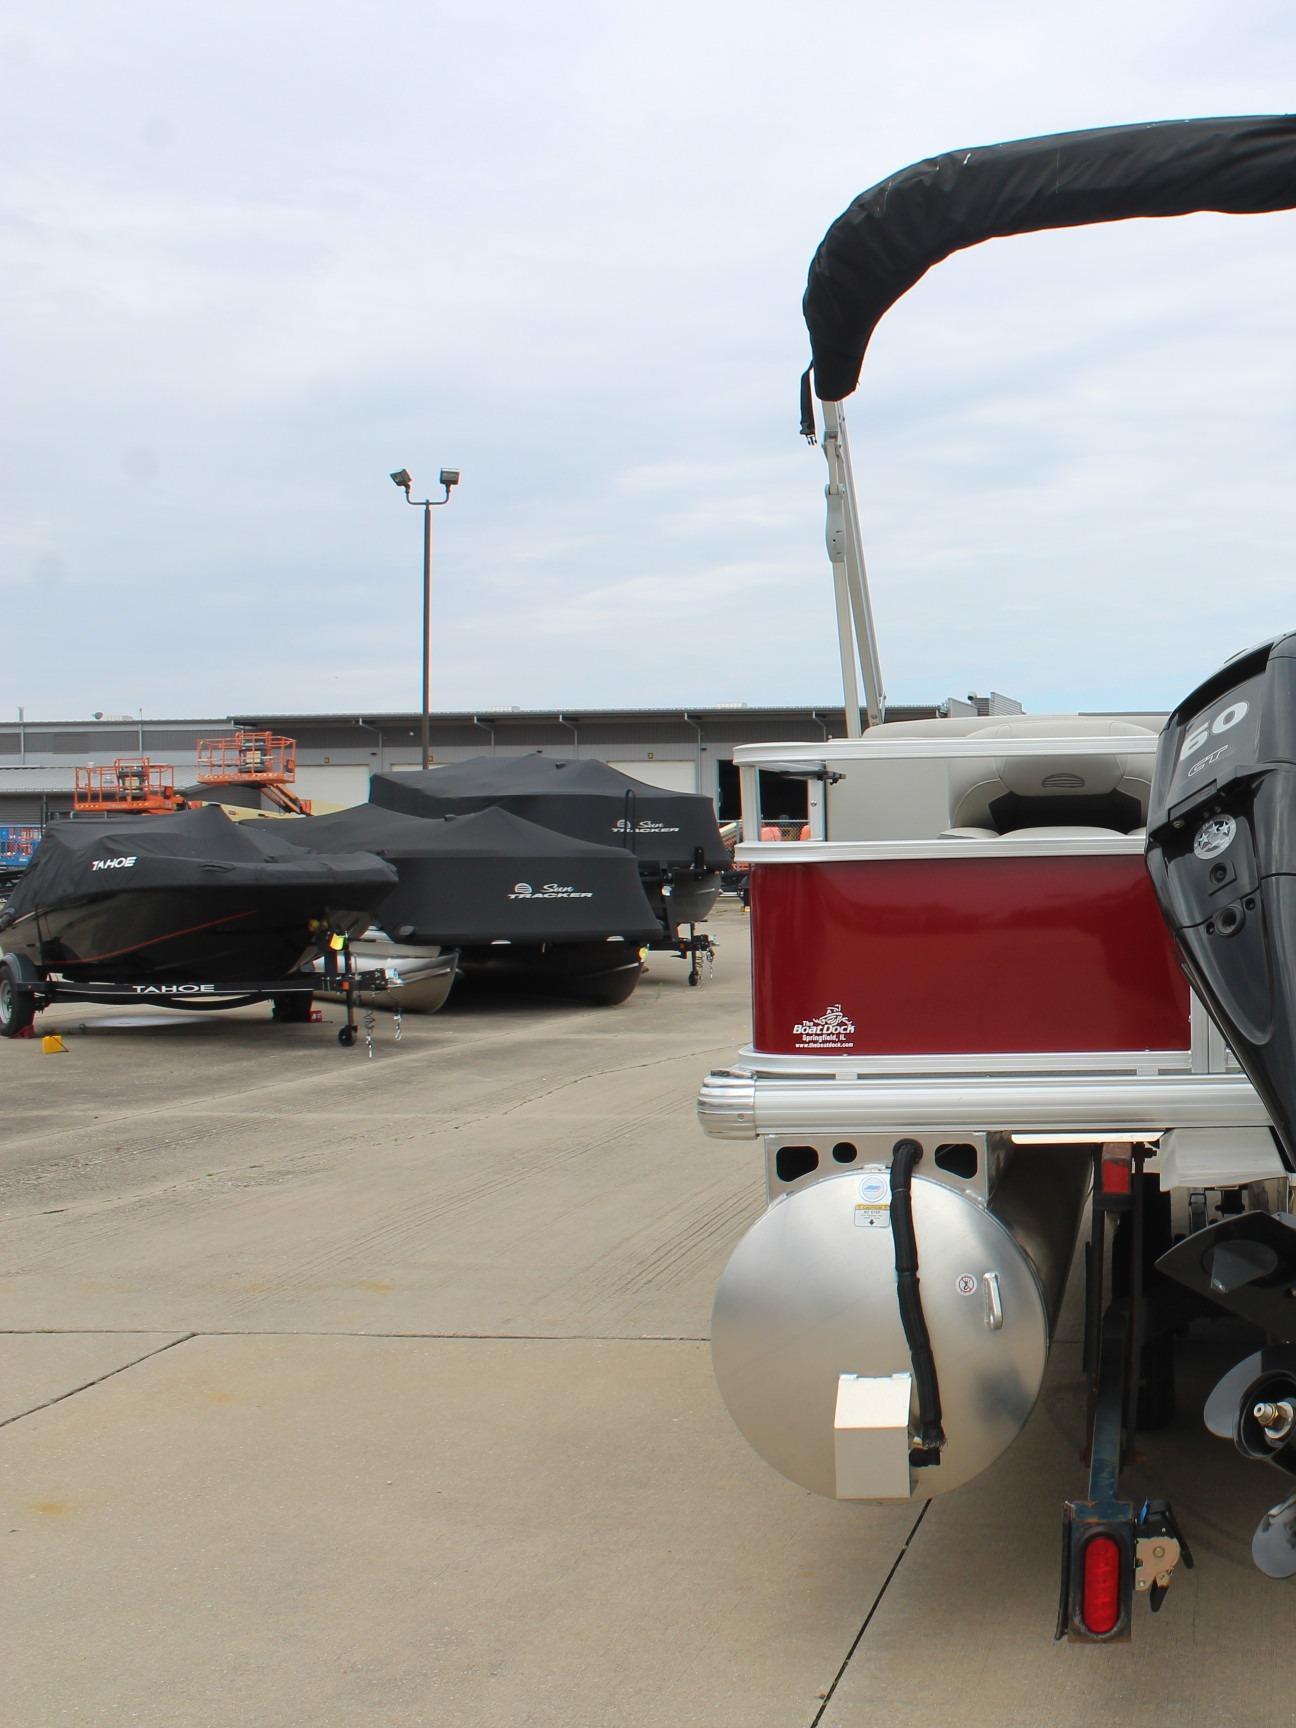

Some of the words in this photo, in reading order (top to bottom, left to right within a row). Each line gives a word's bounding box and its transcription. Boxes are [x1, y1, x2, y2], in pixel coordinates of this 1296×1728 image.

[1180, 702, 1248, 761] 60
[637, 820, 664, 829] Sun
[92, 856, 137, 871] TAHOE
[540, 883, 574, 893] Sun
[132, 984, 215, 993] TAHOE
[802, 1034, 838, 1043] Springfield,
